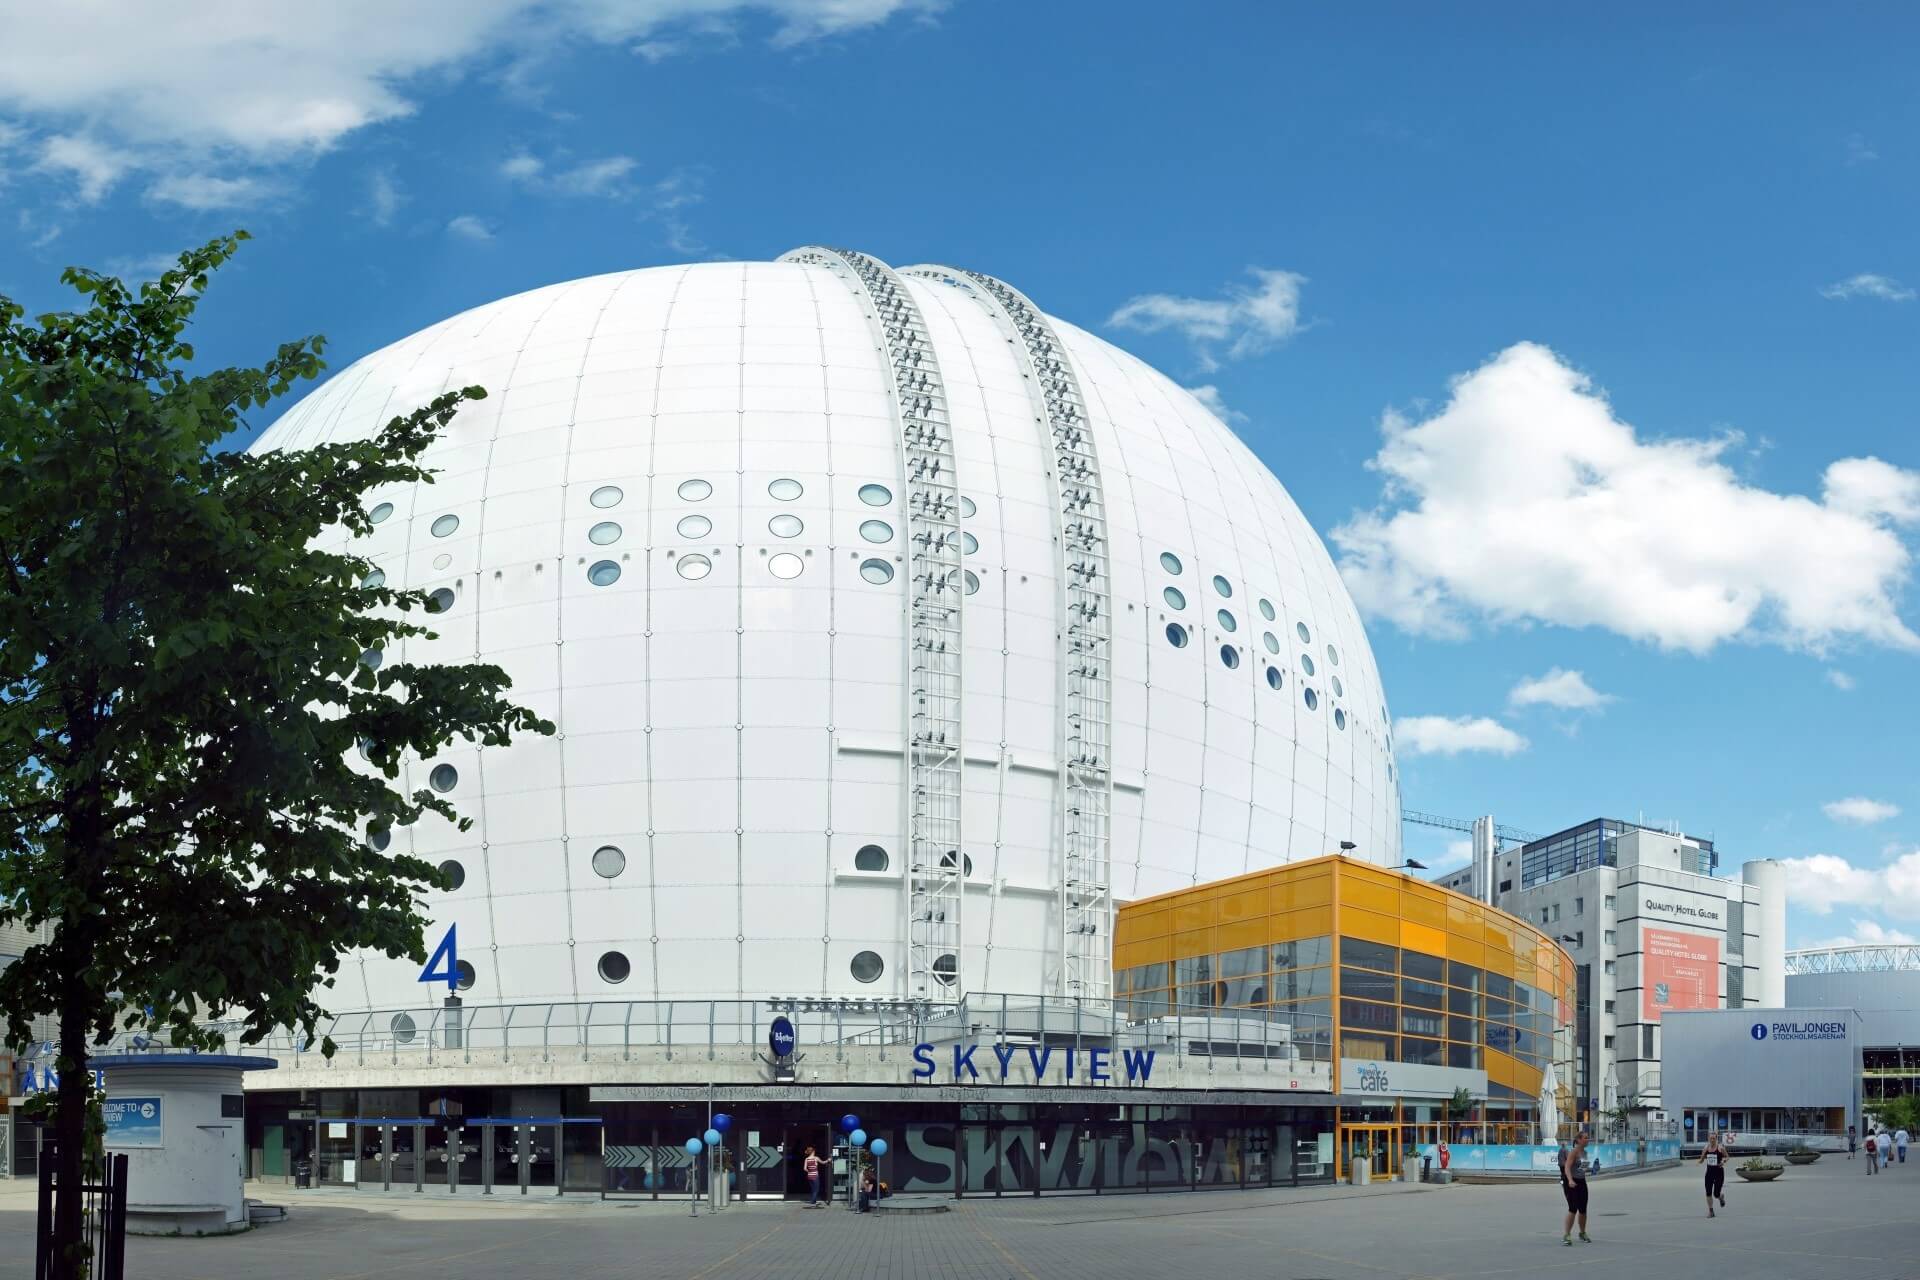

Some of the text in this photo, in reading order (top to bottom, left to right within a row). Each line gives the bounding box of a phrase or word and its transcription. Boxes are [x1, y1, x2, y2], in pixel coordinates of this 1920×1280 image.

[1646, 899, 1719, 920] QUALITY HOTEL GLOBE
[417, 921, 465, 990] 4
[1772, 1022, 1846, 1033] PAVILJONGEN
[912, 1043, 1156, 1081] SKYVIEW
[1360, 1071, 1389, 1092] café
[127, 1102, 137, 1112] TO
